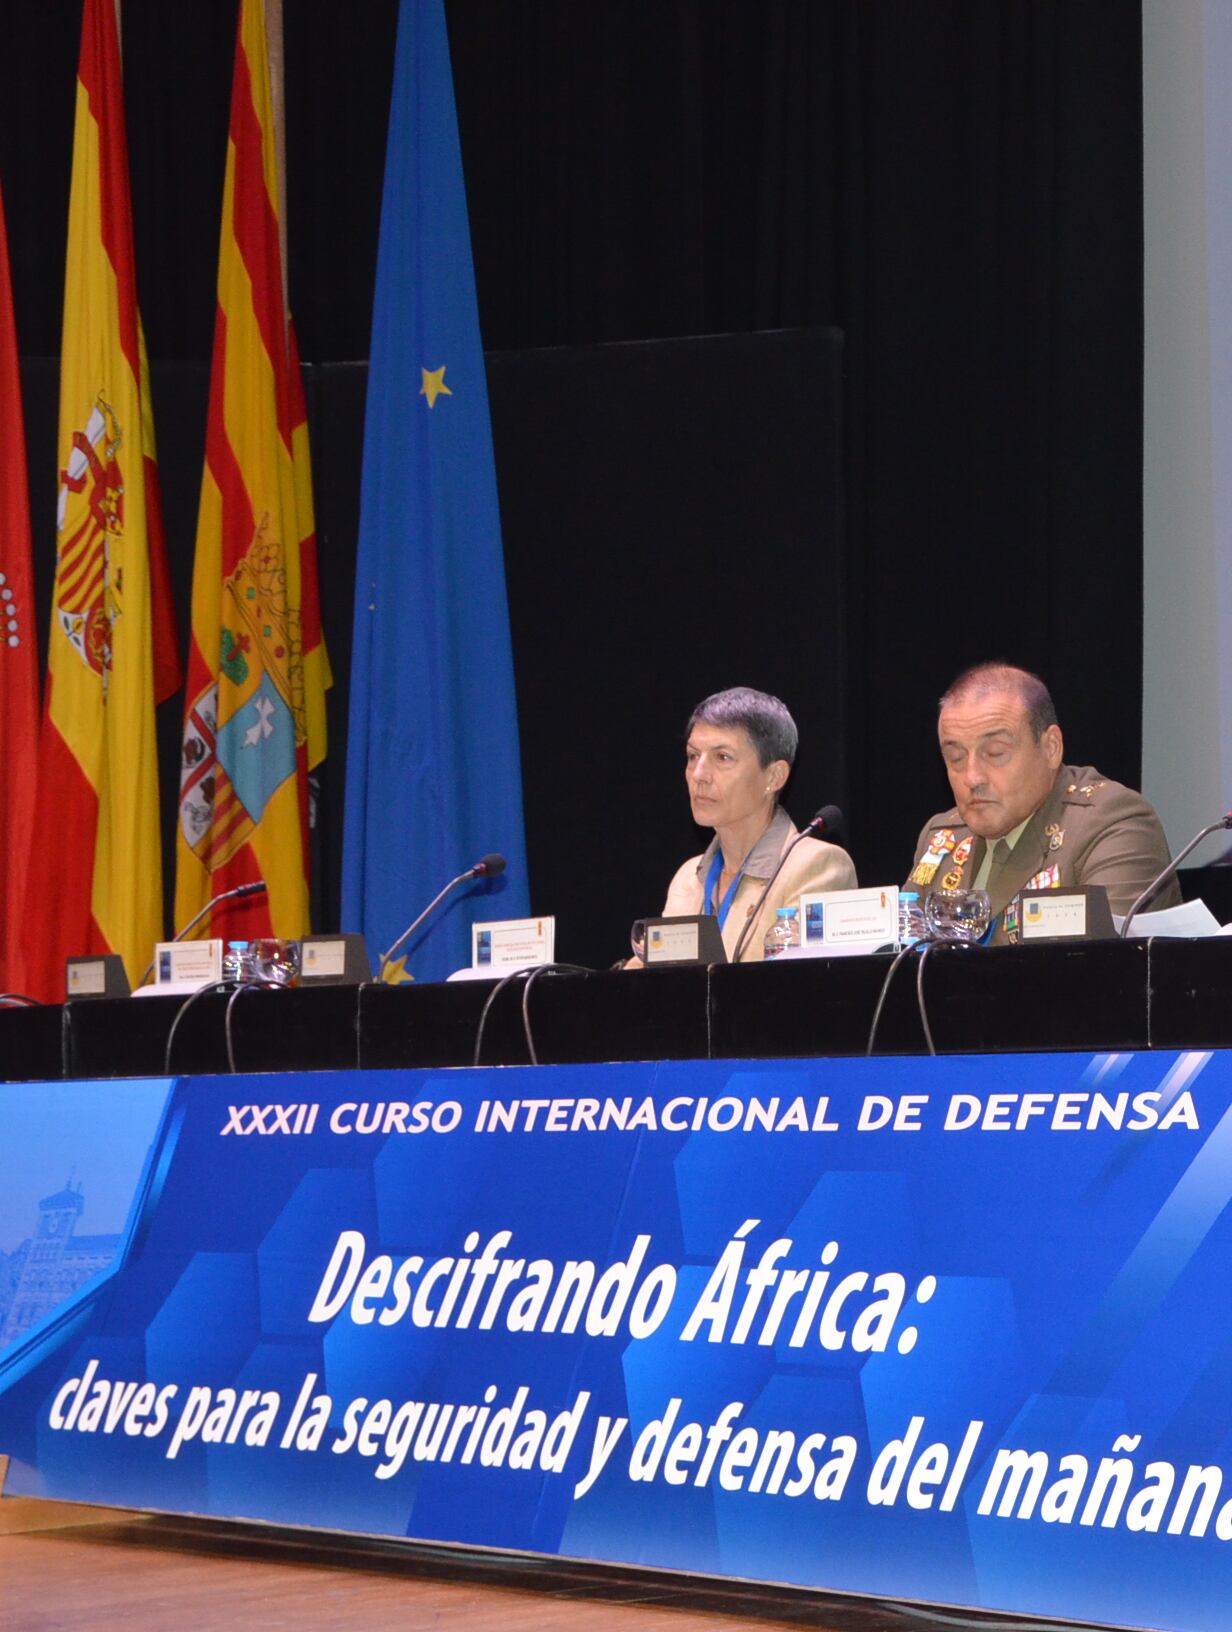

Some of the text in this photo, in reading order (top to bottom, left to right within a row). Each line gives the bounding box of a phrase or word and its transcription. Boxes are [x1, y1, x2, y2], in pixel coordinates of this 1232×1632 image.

[221, 1091, 1200, 1136] XXXII CURSO INTERNACIONAL DE DEFENSA
[308, 1219, 937, 1355] Descifrando África:
[49, 1361, 177, 1437] claves
[166, 1387, 280, 1459] para
[281, 1373, 332, 1451] la
[332, 1384, 590, 1480] seguridad
[574, 1417, 629, 1500] y
[629, 1398, 858, 1501] defensa
[867, 1416, 984, 1512] del
